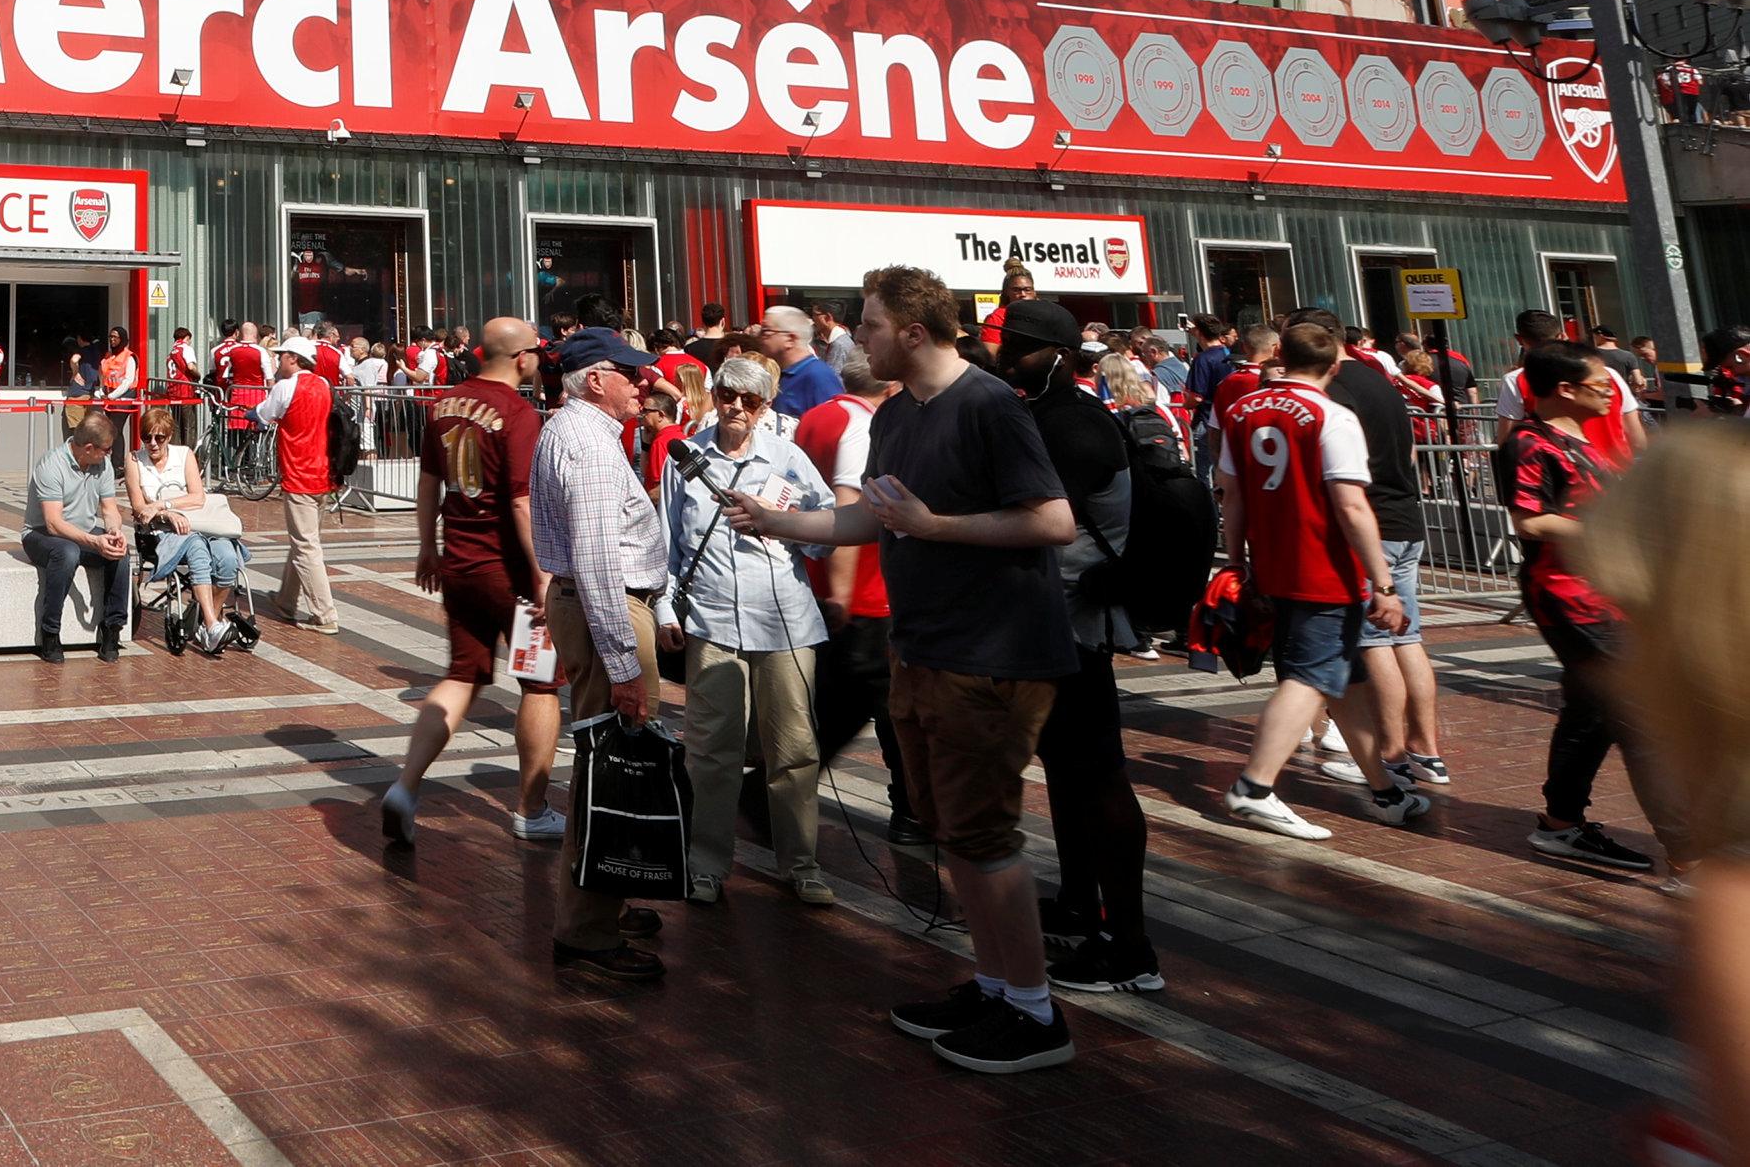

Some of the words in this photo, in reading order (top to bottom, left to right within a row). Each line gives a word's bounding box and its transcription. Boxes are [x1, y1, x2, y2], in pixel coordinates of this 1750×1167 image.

[1073, 73, 1096, 85] 1998
[1153, 79, 1174, 91] 1999
[1229, 86, 1251, 98] 2002
[1558, 82, 1607, 100] Arsenal
[1301, 92, 1322, 103] 2004
[1371, 98, 1392, 109] 2014
[1440, 103, 1459, 114] 2015
[1504, 109, 1523, 120] 2017
[74, 195, 107, 208] Arsenal
[291, 241, 327, 251] ARSENAL
[955, 233, 1002, 262] The
[1009, 235, 1100, 265] Arsenal
[536, 248, 563, 257] RSENAL
[1054, 266, 1101, 280] ARMOURY
[1405, 274, 1445, 285] QUEUE
[1231, 396, 1316, 427] LACAZETTE
[440, 424, 484, 499] 10
[1250, 426, 1290, 491] 9
[597, 862, 627, 877] HOUSE
[629, 869, 642, 879] OF
[644, 870, 673, 881] FRASER
